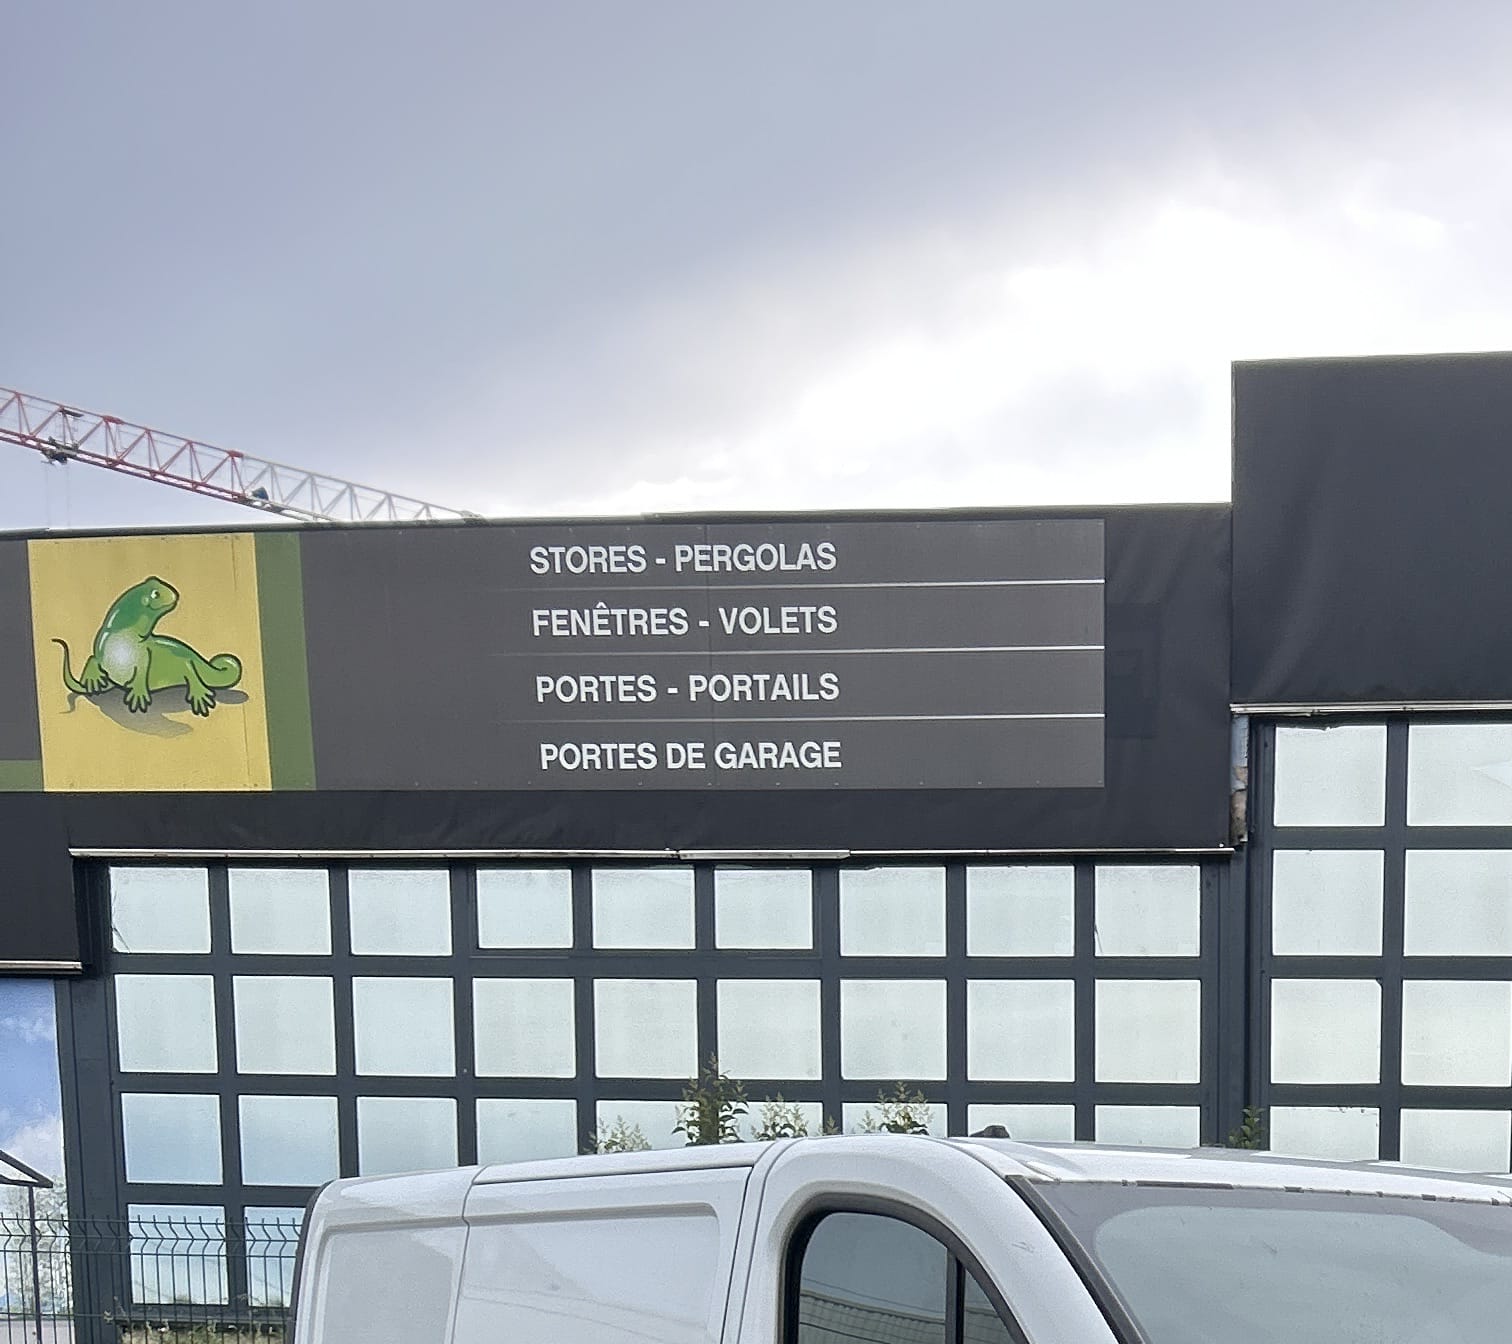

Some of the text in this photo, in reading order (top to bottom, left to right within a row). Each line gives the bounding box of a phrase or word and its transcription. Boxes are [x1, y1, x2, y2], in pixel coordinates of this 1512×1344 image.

[530, 542, 837, 574] STORES - PERGOLAS
[532, 601, 689, 637] FENÊTRES
[718, 605, 838, 635] VOLETS
[536, 674, 657, 703] PORTES
[688, 672, 840, 702] PORTAILS
[540, 741, 842, 770] PORTES DE GARAGE
